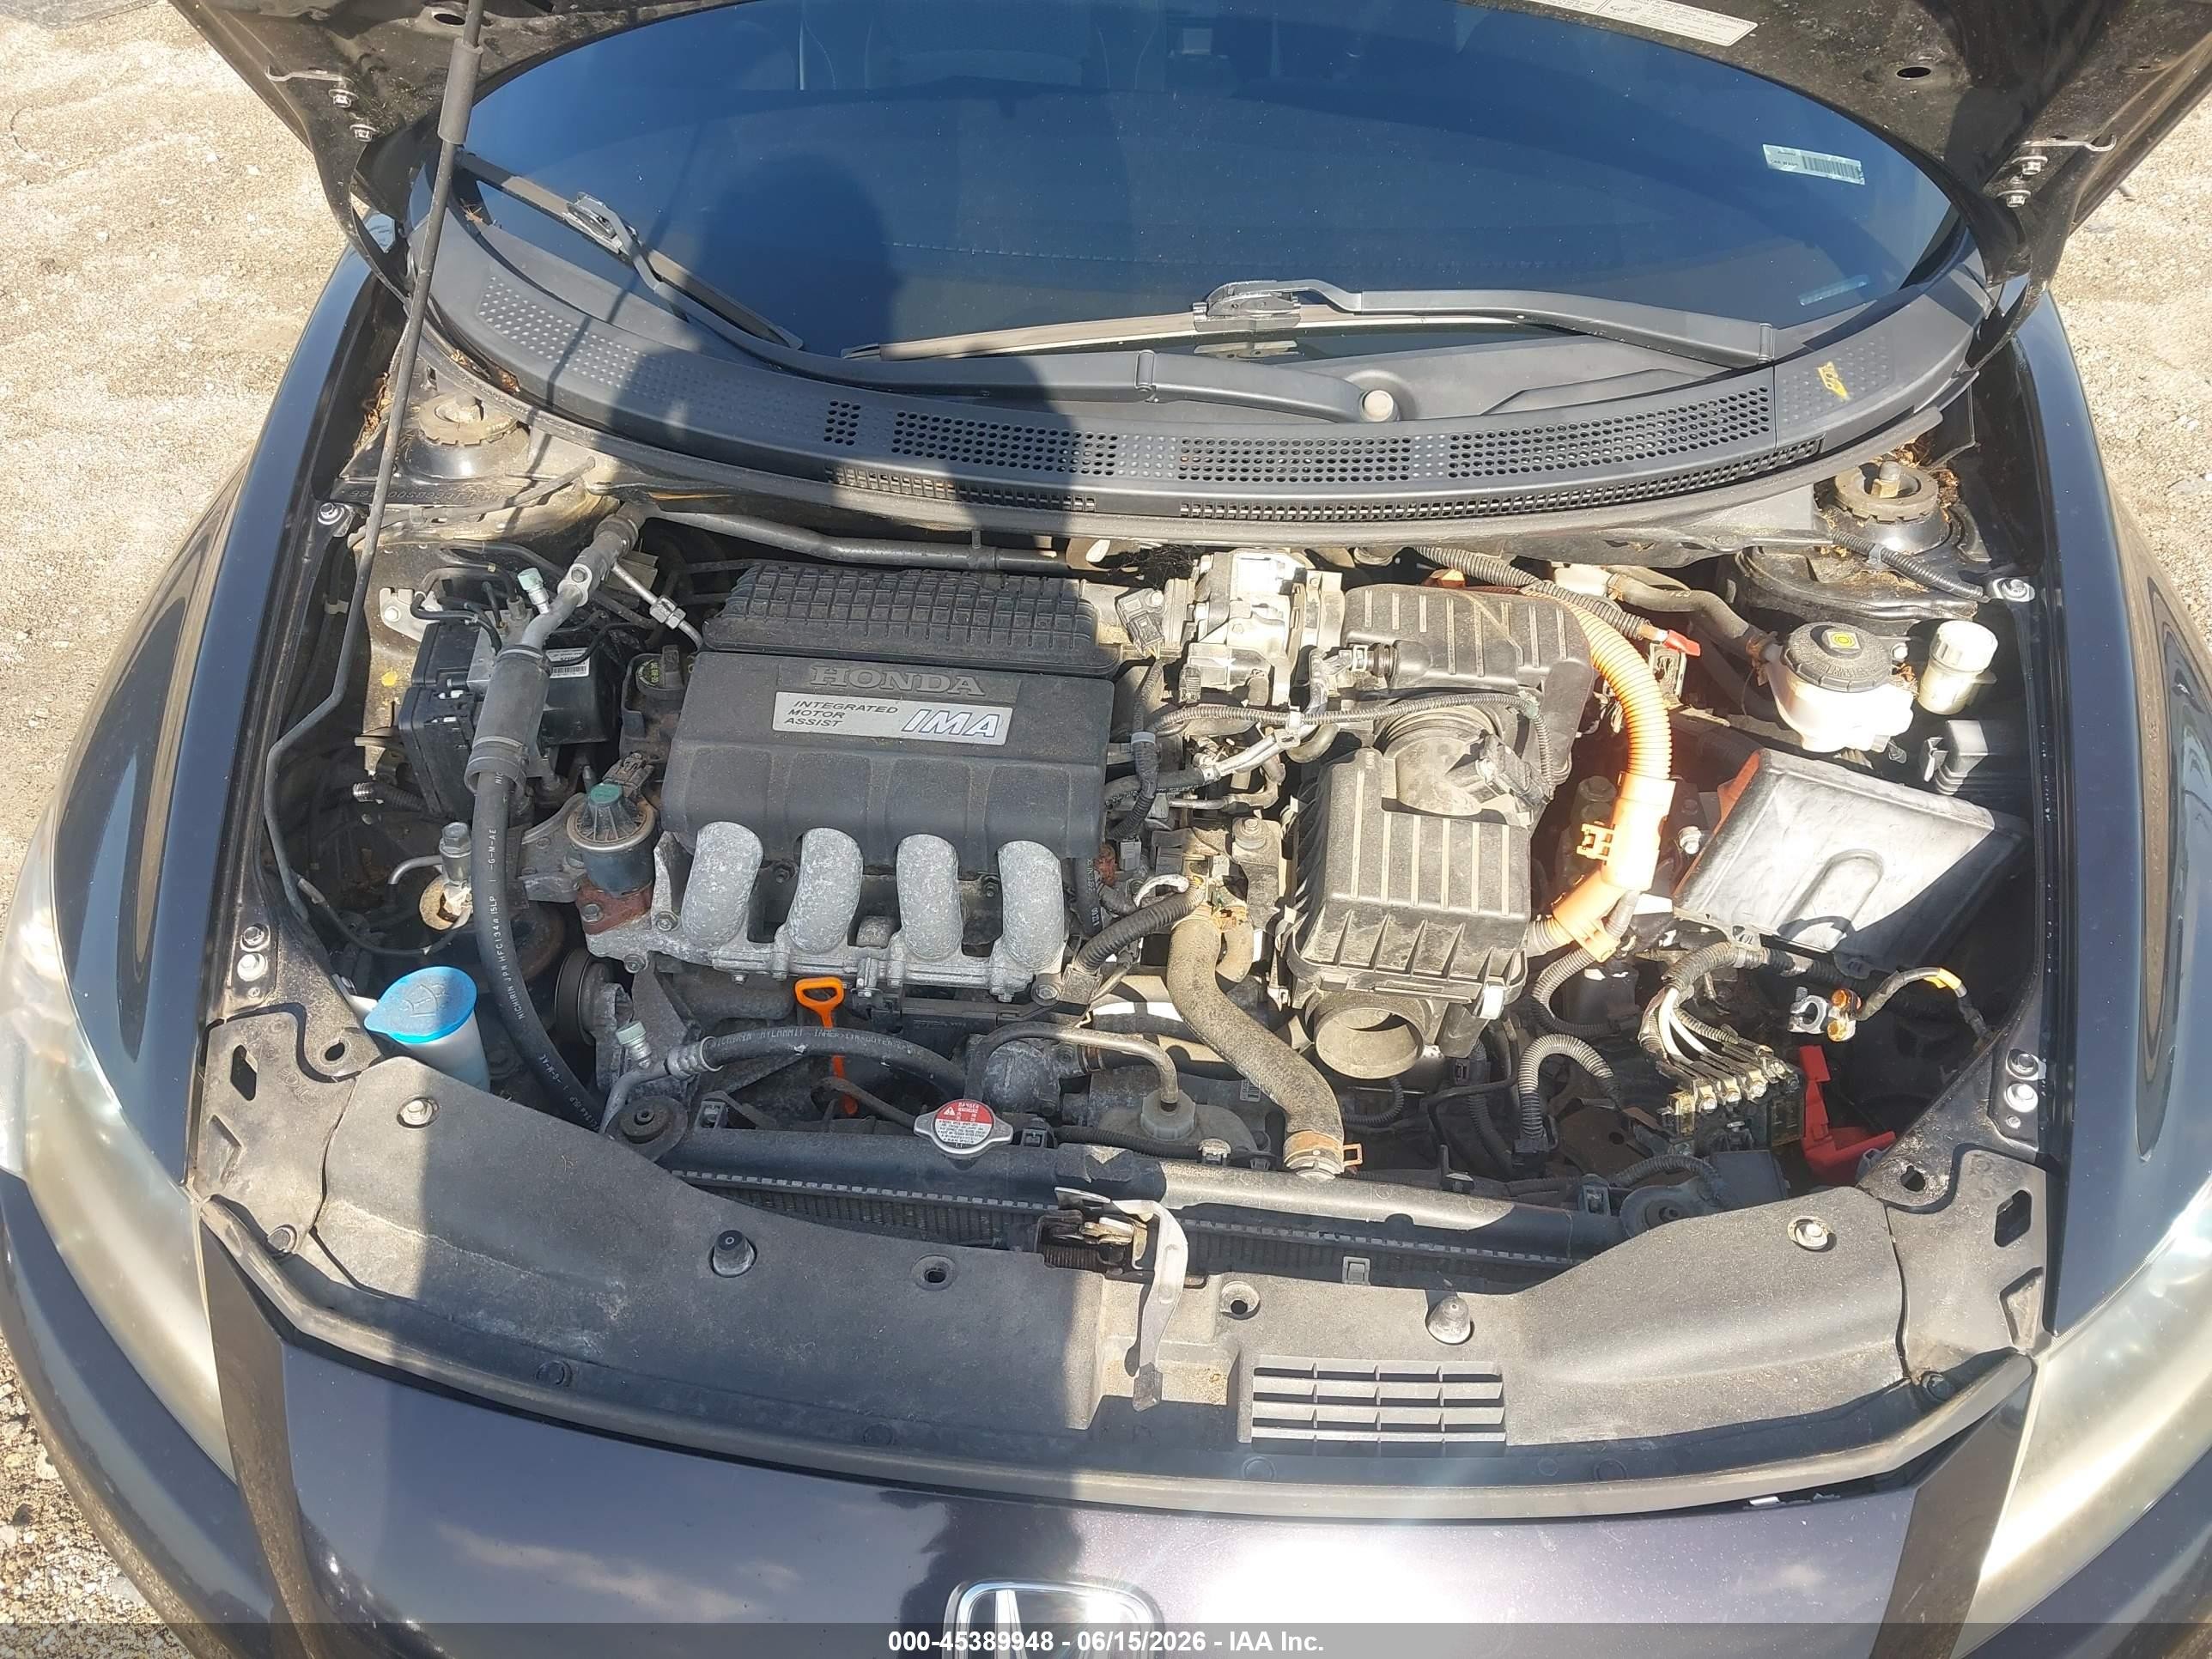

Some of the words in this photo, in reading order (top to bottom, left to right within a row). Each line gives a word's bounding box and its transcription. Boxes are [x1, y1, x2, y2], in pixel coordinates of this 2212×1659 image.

[810, 665, 986, 696] HONDA
[787, 708, 846, 719] MOTOR
[793, 700, 898, 714] INTEGRATED
[784, 717, 843, 728] ASSIST
[902, 709, 1001, 738] IMA
[507, 984, 526, 1020] NICHIRIN
